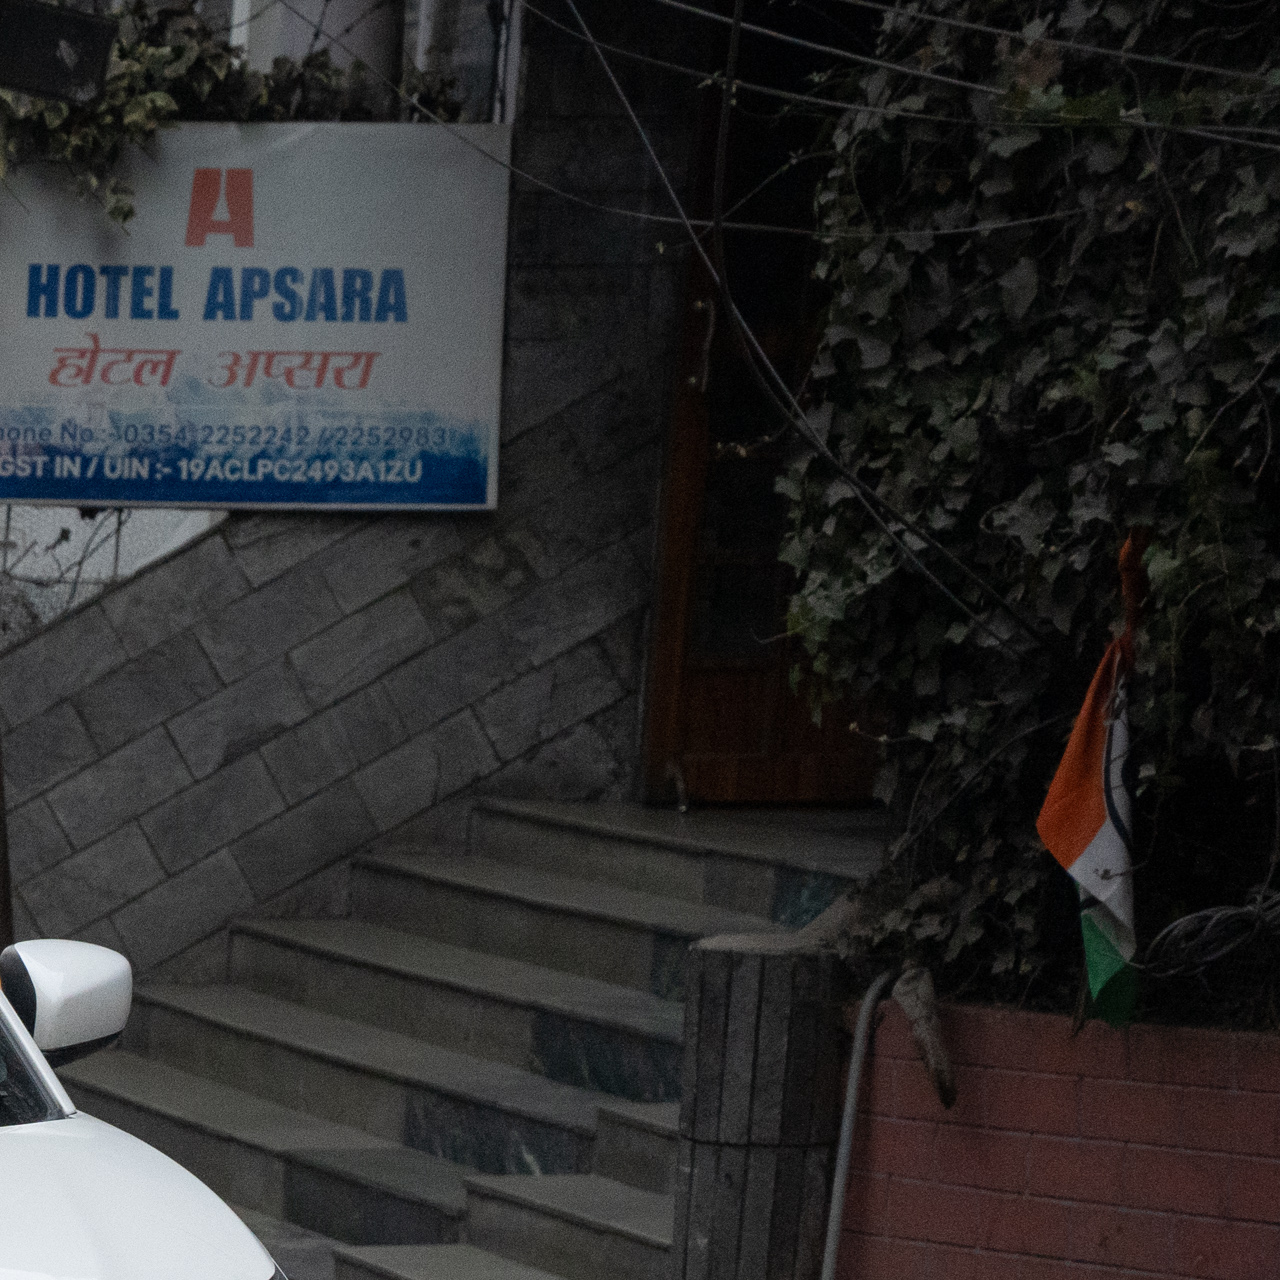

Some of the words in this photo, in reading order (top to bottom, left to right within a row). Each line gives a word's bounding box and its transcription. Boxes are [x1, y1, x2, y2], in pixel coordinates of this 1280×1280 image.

[26, 263, 180, 321] HOTEL
[202, 266, 409, 323] APSARA
[48, 332, 183, 388] होटल
[207, 350, 383, 390] अप्सरा
[54, 456, 81, 478] IN
[86, 457, 99, 478] /
[103, 457, 150, 479] UIN
